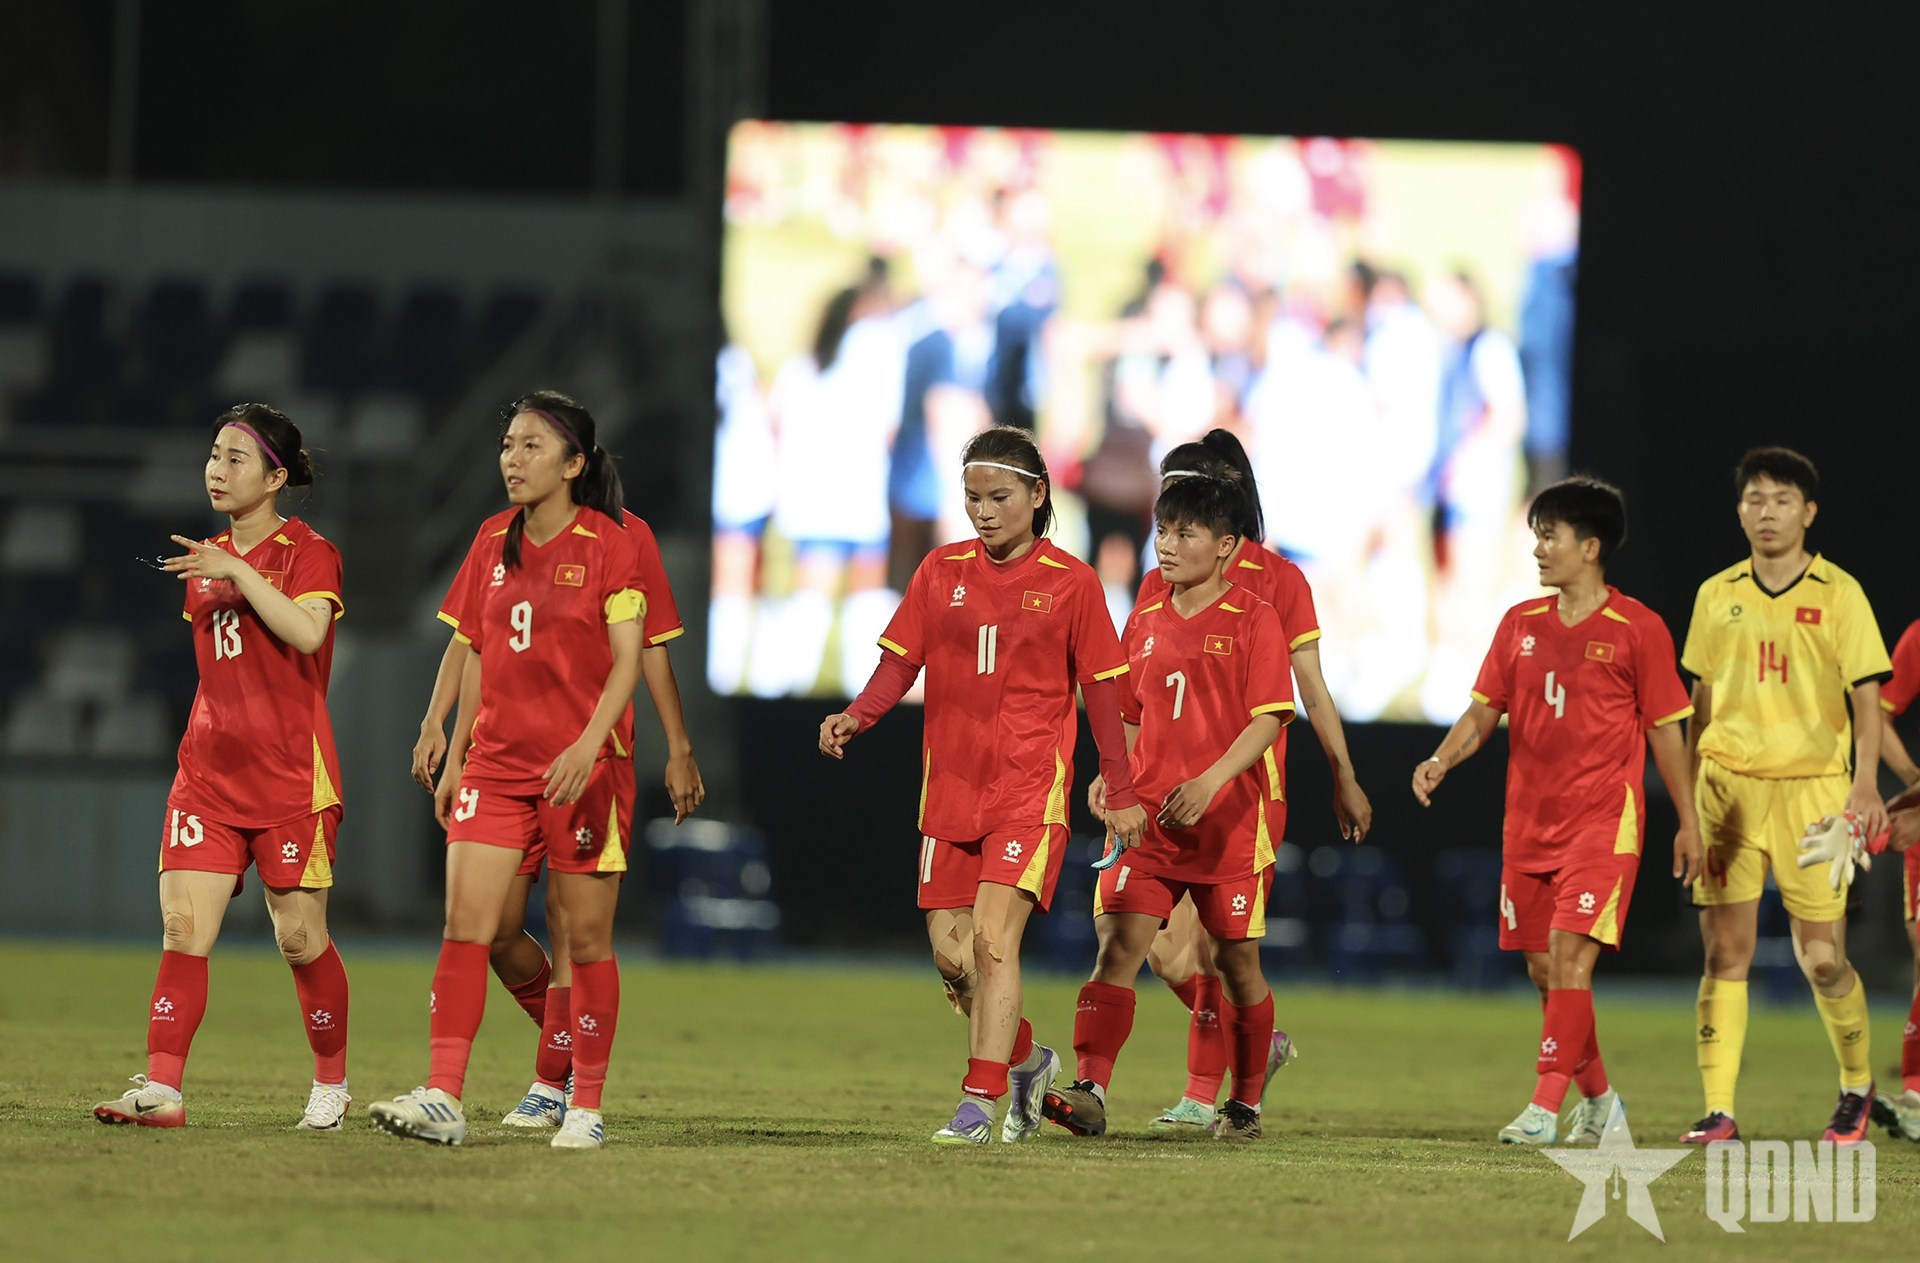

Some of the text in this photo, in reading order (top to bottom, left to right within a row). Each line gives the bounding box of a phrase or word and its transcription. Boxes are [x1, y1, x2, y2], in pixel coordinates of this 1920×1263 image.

[213, 609, 243, 661] 13
[509, 601, 533, 653] 9
[978, 624, 998, 675] 11
[1758, 641, 1788, 684] 14
[1165, 670, 1186, 721] 7
[1544, 670, 1566, 719] 4
